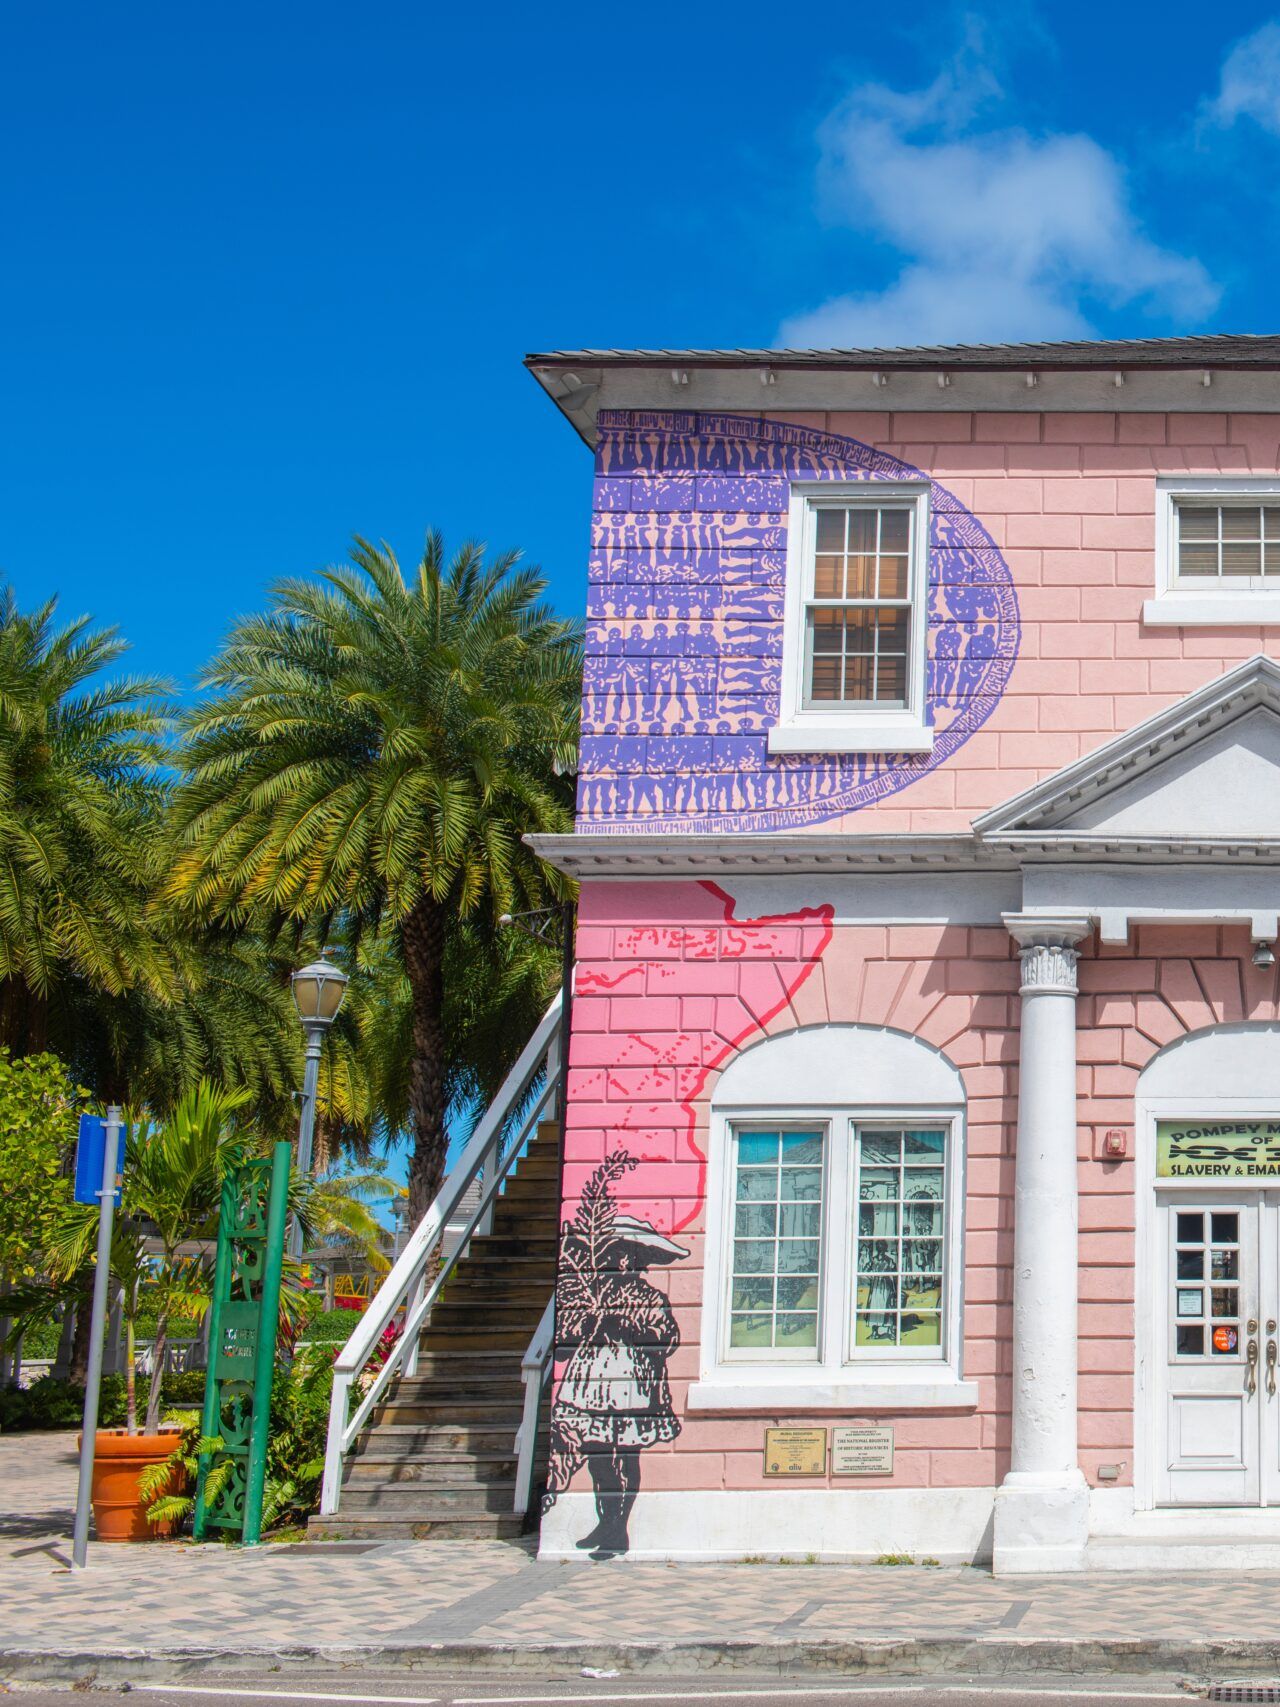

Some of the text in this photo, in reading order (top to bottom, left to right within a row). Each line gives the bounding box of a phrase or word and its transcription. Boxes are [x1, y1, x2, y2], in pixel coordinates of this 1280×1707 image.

[1170, 1124, 1261, 1143] POMPEY
[1250, 1136, 1274, 1145] OF
[1171, 1164, 1232, 1176] SLAVERY
[1234, 1166, 1244, 1176] &
